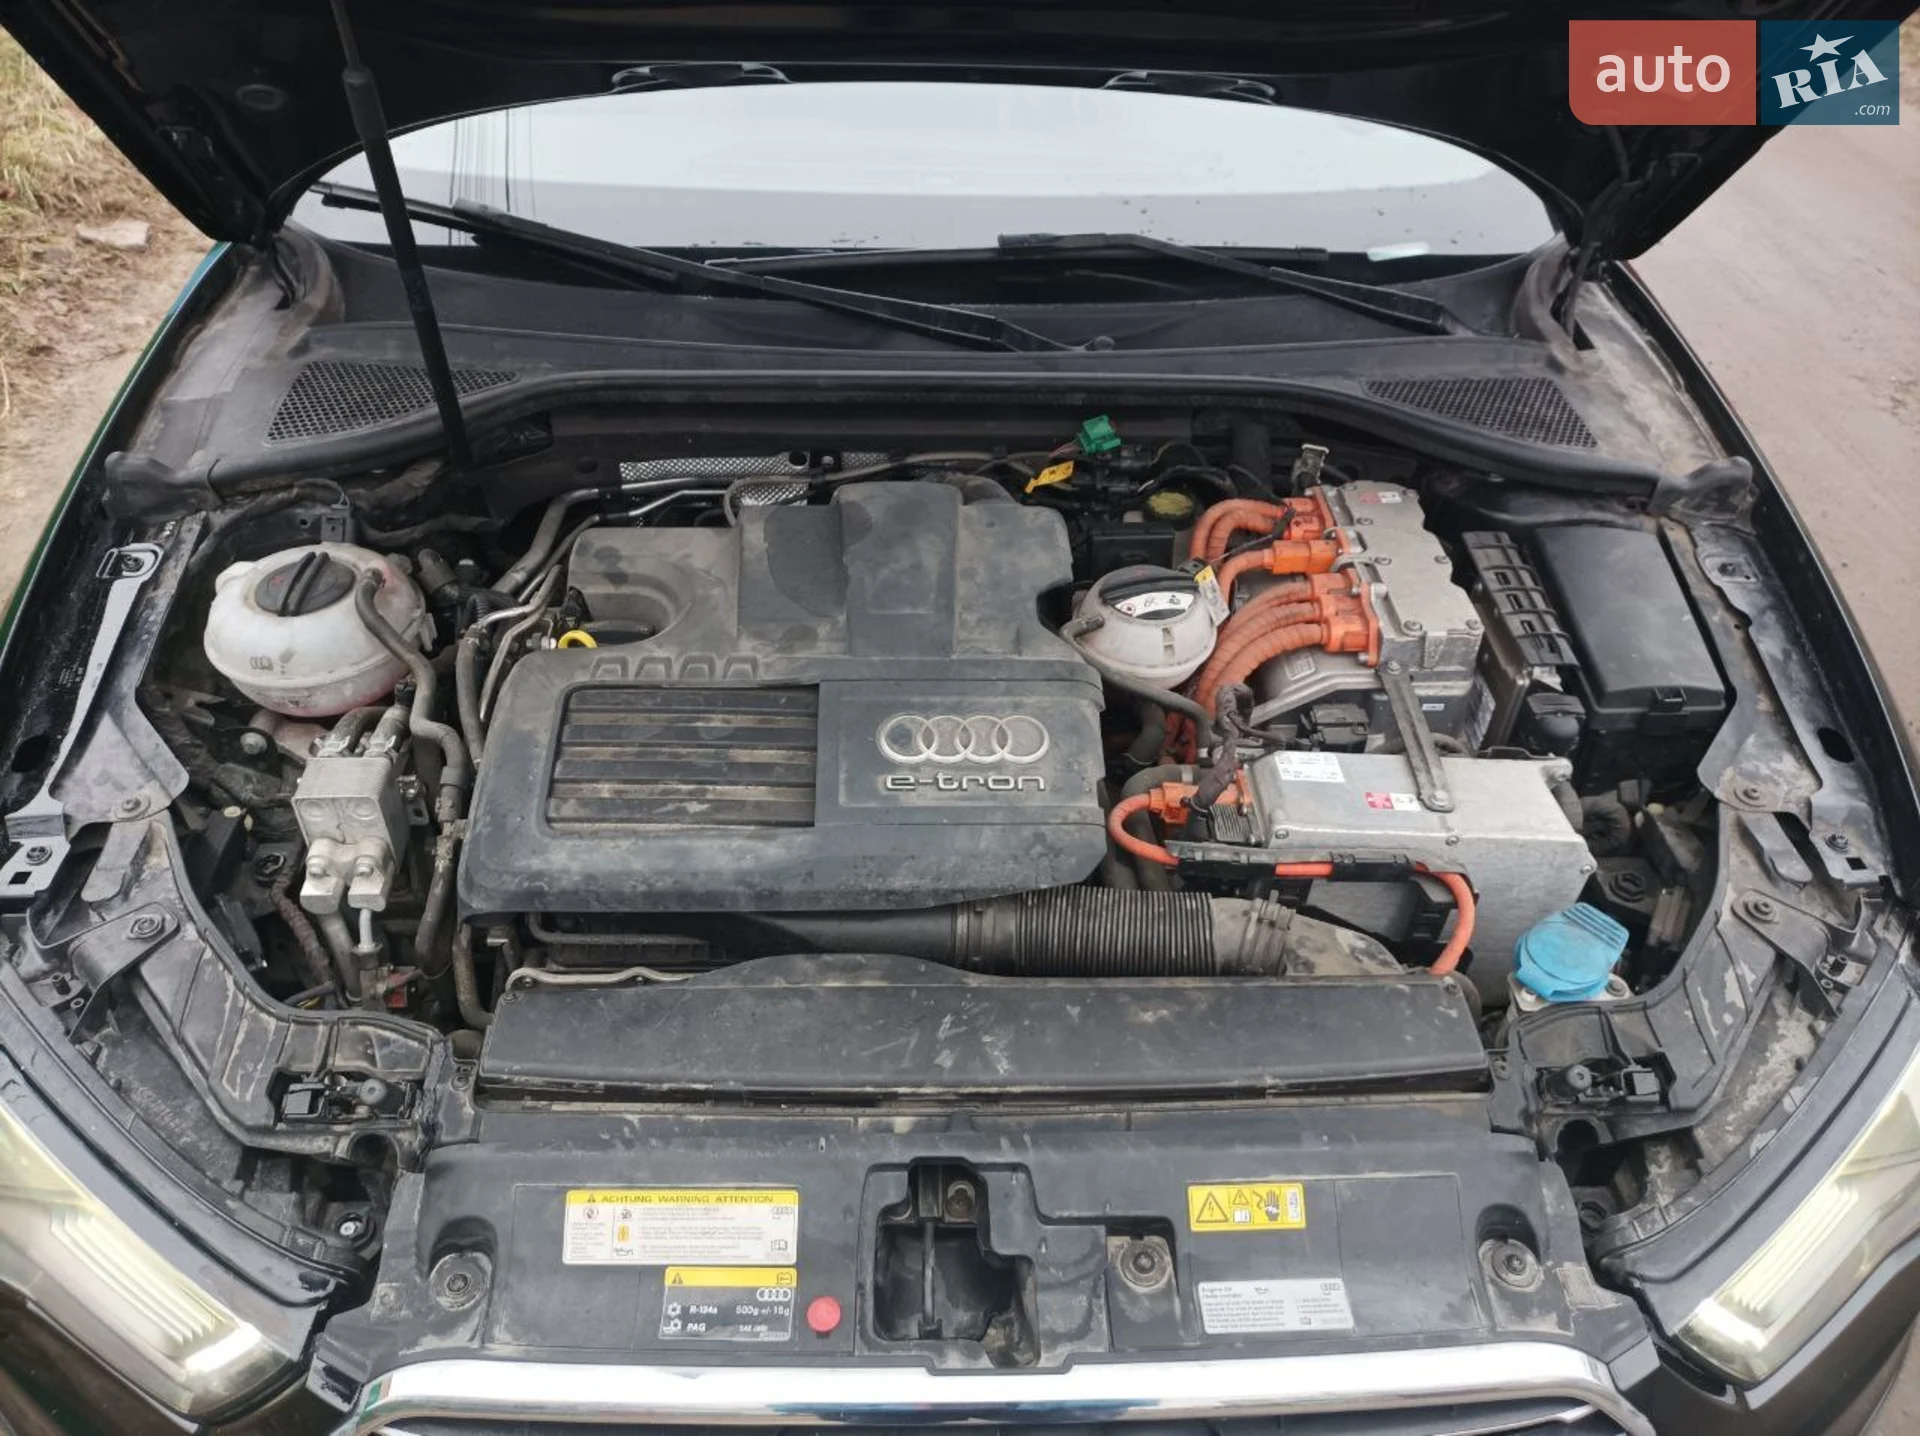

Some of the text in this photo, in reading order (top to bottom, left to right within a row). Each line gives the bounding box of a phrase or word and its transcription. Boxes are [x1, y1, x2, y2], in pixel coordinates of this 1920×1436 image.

[885, 771, 1045, 791] e-tron
[602, 1195, 773, 1203] ACHTUNG WARNING ATTENTION
[686, 1322, 706, 1332] PAG
